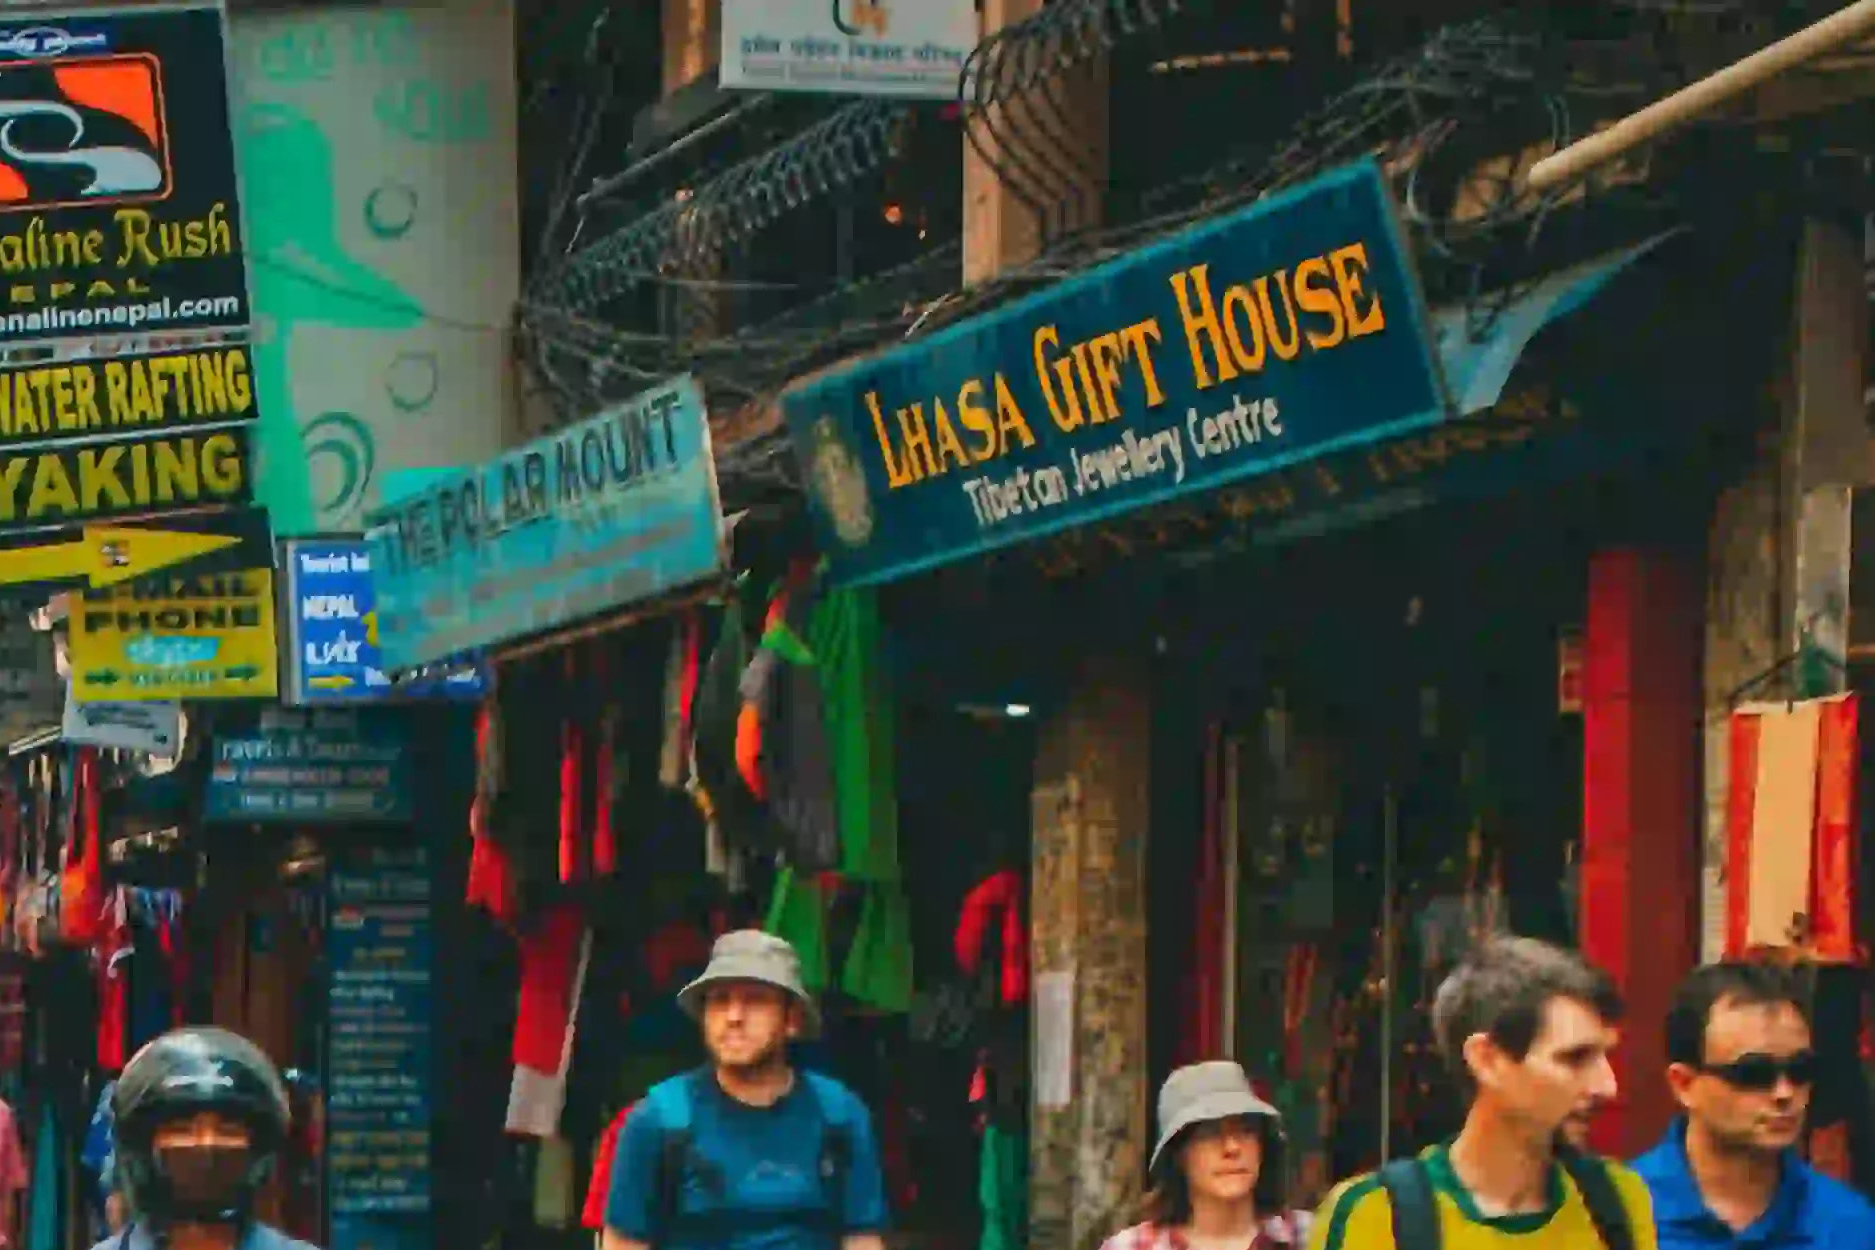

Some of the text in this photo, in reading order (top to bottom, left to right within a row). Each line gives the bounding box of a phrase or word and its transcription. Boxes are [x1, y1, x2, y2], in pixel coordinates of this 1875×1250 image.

[112, 202, 232, 268] Rush
[104, 349, 253, 421] RAFTING
[864, 241, 1387, 490] LHASA GIFT HOUSE
[961, 464, 1070, 527] Tibetan
[1069, 426, 1185, 497] Jewellery
[1186, 396, 1283, 459] Centre
